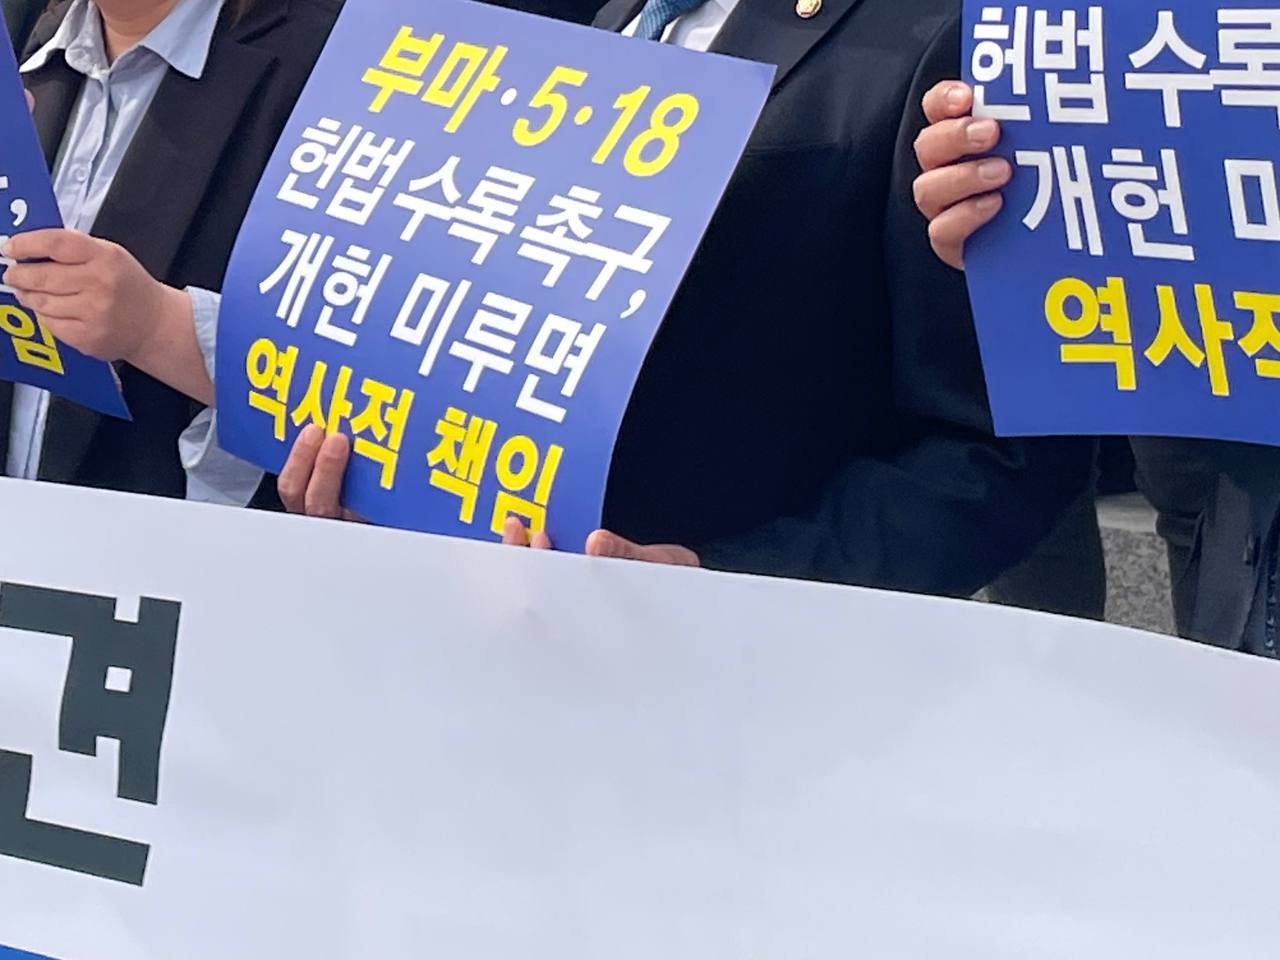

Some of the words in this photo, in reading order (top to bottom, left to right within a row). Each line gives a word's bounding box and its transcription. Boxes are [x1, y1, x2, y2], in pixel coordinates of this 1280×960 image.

[361, 24, 700, 178] 부마·5·18
[970, 5, 1109, 125] 헌법
[276, 116, 415, 226] 헌법
[392, 154, 536, 265] 수록
[517, 184, 674, 321] 촉구,
[1014, 145, 1196, 261] 개헌
[257, 226, 393, 349] 개헌
[389, 271, 608, 425] 미루면
[244, 336, 415, 490] 역사적
[426, 405, 564, 543] 책임
